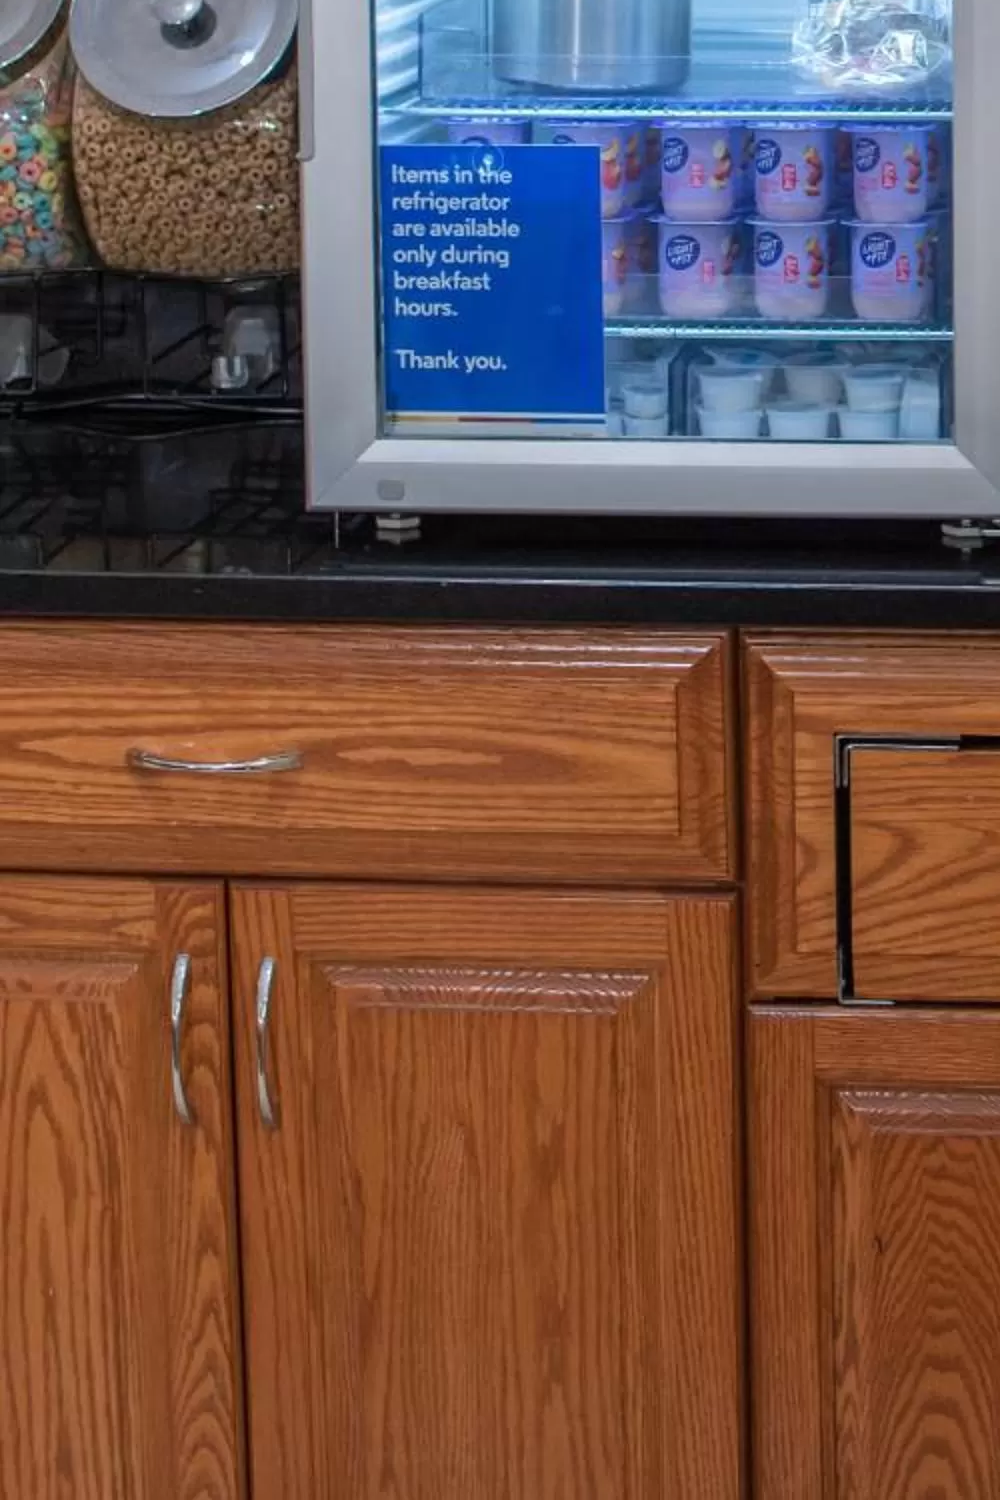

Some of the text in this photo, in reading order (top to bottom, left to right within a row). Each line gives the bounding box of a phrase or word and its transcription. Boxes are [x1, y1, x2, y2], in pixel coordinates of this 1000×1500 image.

[391, 163, 513, 184] Items in the
[391, 190, 511, 215] refrigerator
[392, 217, 520, 238] are available
[393, 243, 511, 269] only during
[393, 269, 492, 291] breakfast
[395, 295, 459, 317] hours.
[394, 348, 508, 374] Thank you.
